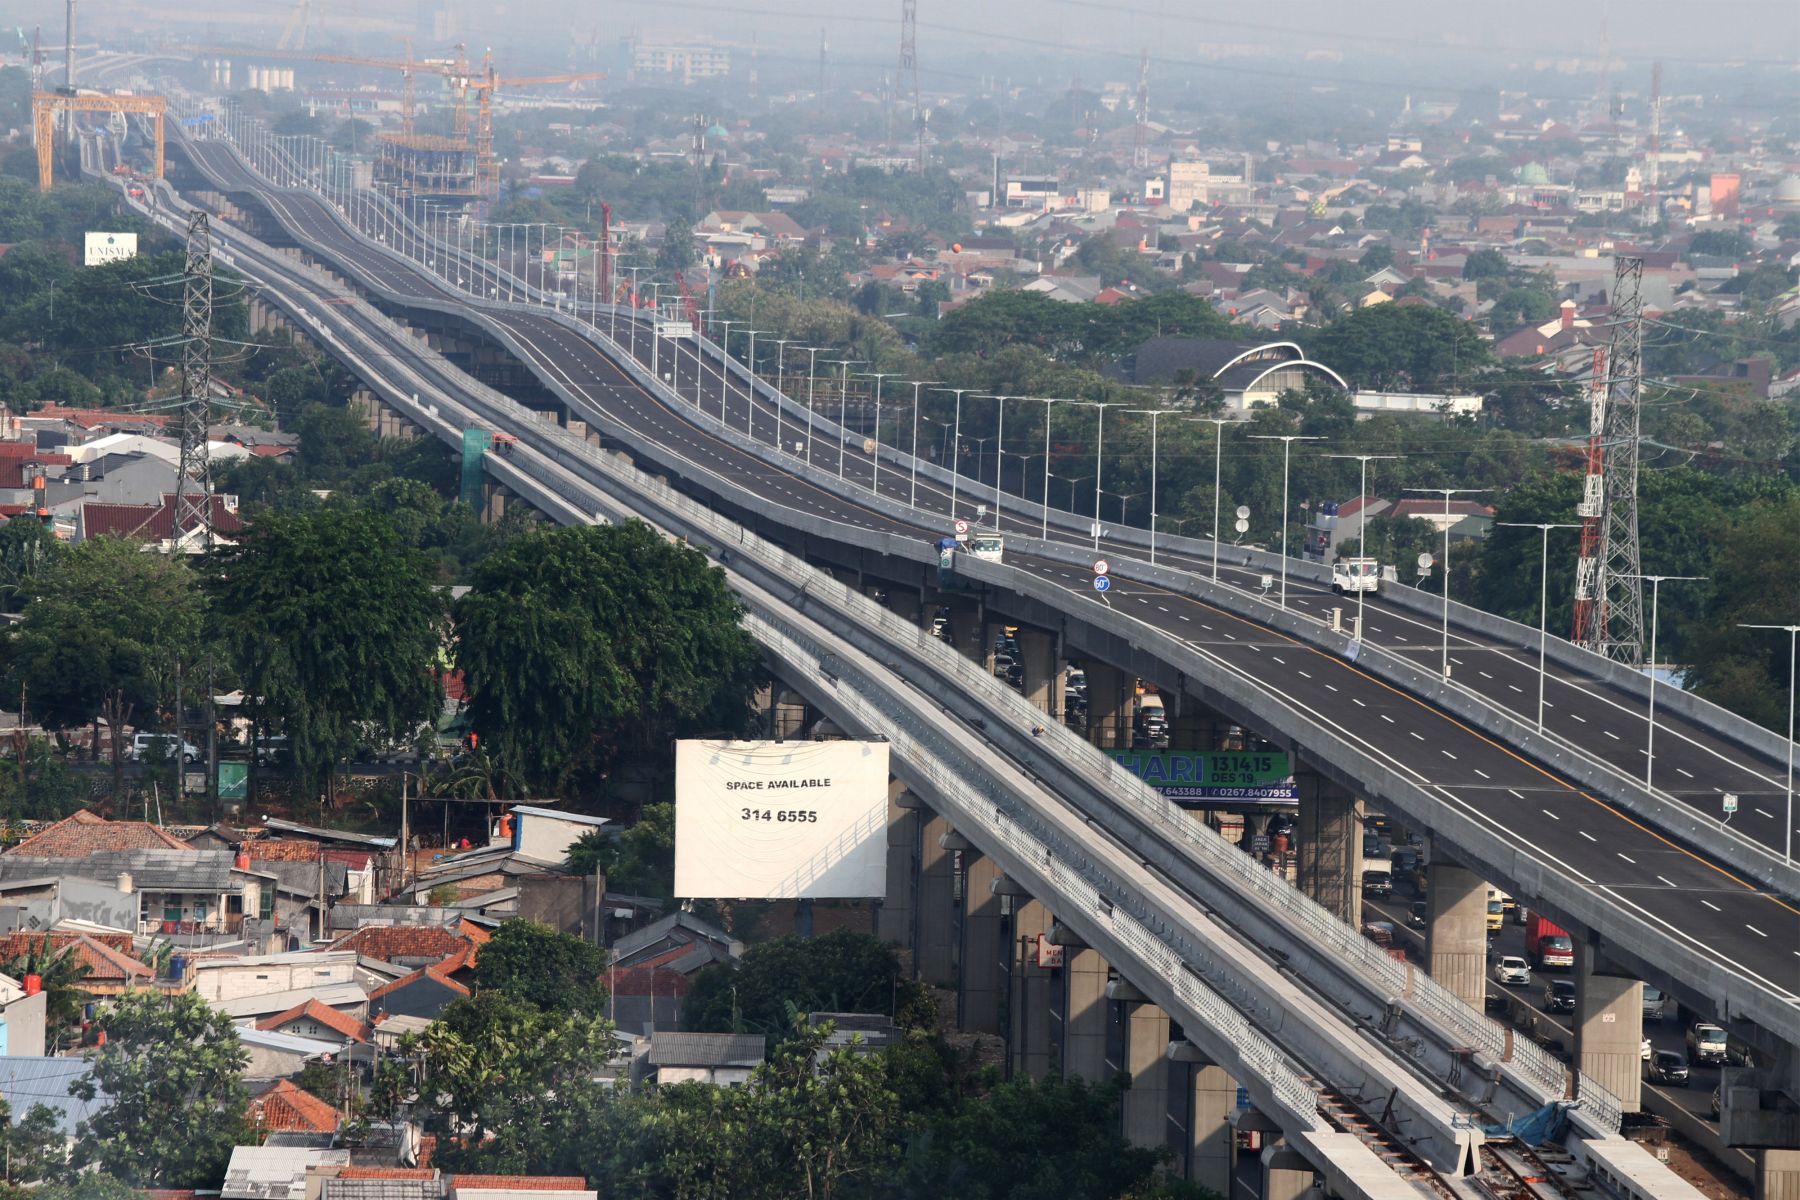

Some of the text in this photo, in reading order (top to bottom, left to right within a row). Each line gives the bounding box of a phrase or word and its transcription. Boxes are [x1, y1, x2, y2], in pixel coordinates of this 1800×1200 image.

[89, 247, 135, 257] UNISMA
[1116, 754, 1204, 783] HARI
[726, 778, 831, 791] SPACE AVAILABLE
[1211, 773, 1236, 783] DES
[741, 808, 818, 823] 314 6555
